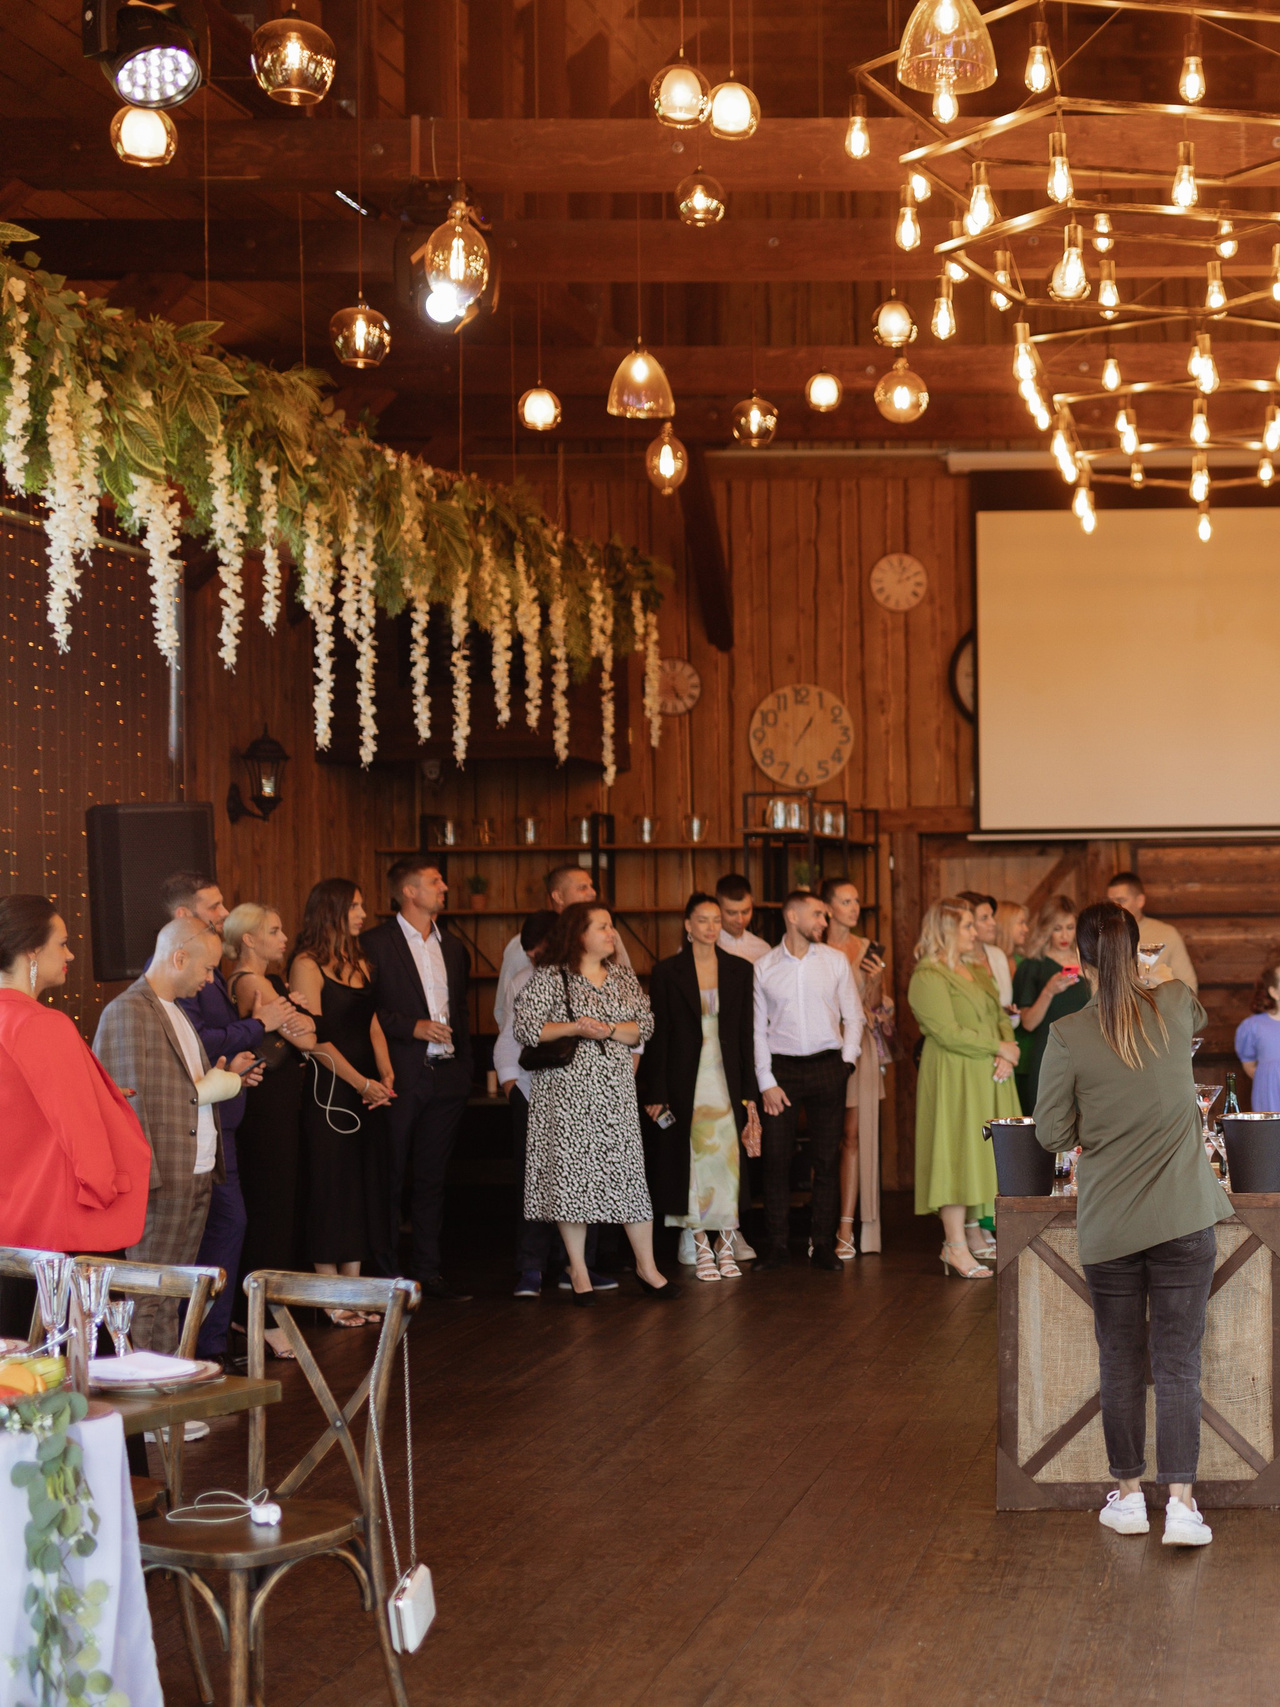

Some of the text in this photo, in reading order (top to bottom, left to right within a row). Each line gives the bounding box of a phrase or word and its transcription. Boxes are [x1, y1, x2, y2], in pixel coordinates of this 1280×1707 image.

[776, 693, 788, 711] 11
[793, 686, 810, 706] 12
[817, 691, 823, 709] 1
[760, 709, 778, 727] 10
[831, 705, 843, 723] 2
[752, 727, 766, 746] 9
[839, 726, 851, 745] 3
[761, 748, 775, 767] 8
[831, 747, 843, 763] 4
[778, 761, 790, 780] 7
[796, 767, 809, 785] 6
[816, 760, 829, 779] 5
